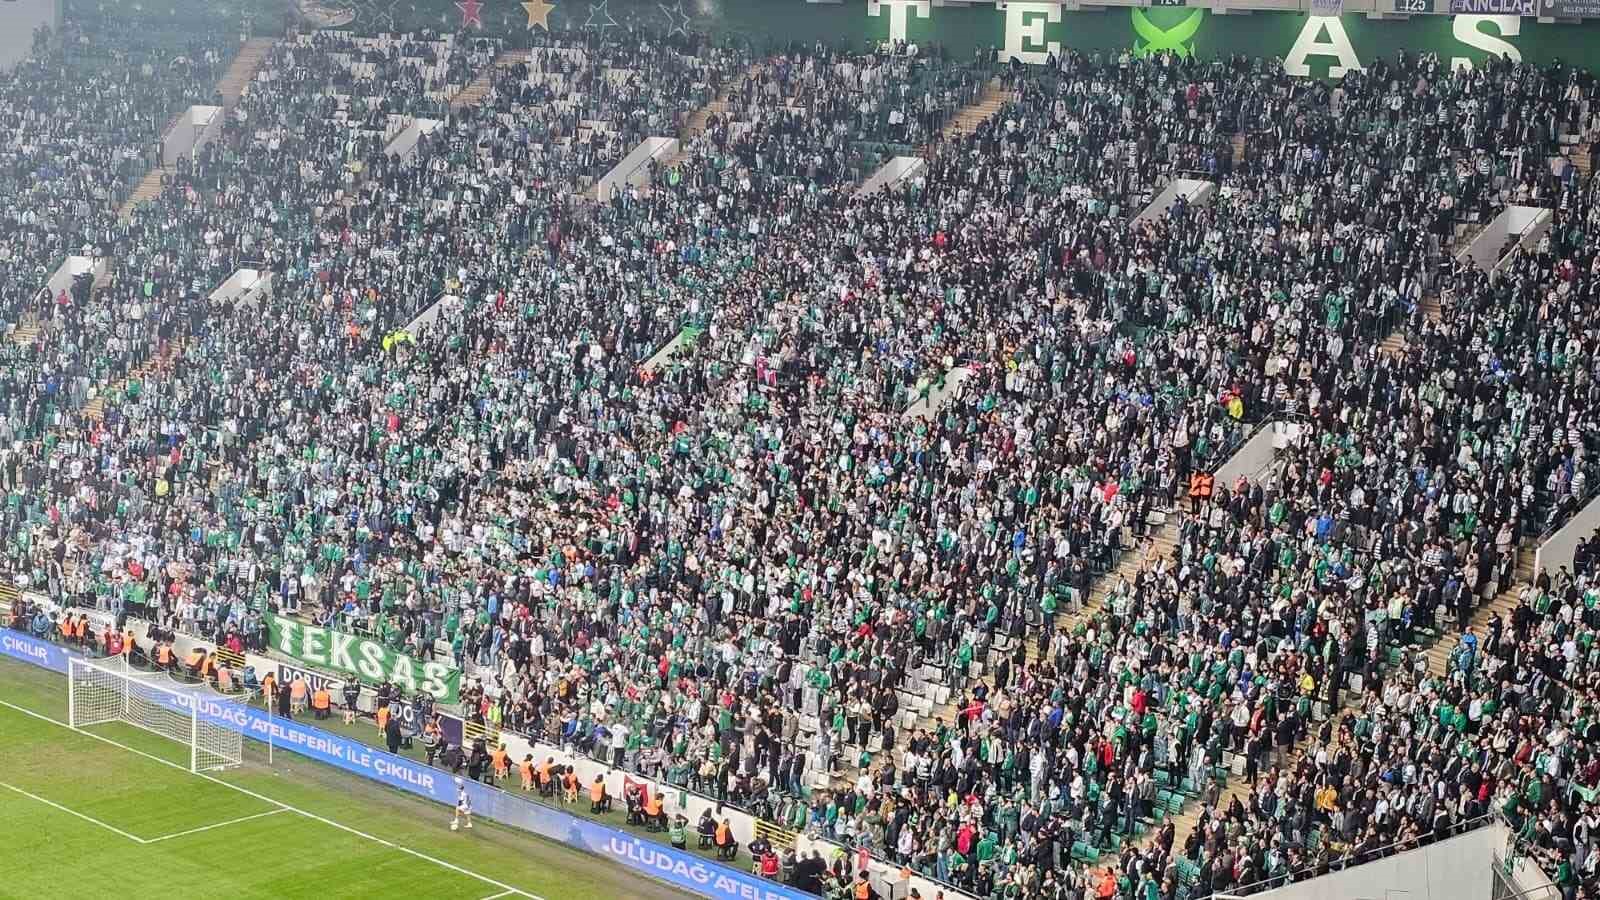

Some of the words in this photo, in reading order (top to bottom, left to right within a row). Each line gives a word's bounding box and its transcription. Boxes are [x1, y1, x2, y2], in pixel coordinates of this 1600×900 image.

[2, 635, 48, 663] ÇIKILIR
[274, 615, 449, 699] TEKSAS
[346, 749, 371, 767] İLE
[373, 757, 434, 791] ÇIKILIR
